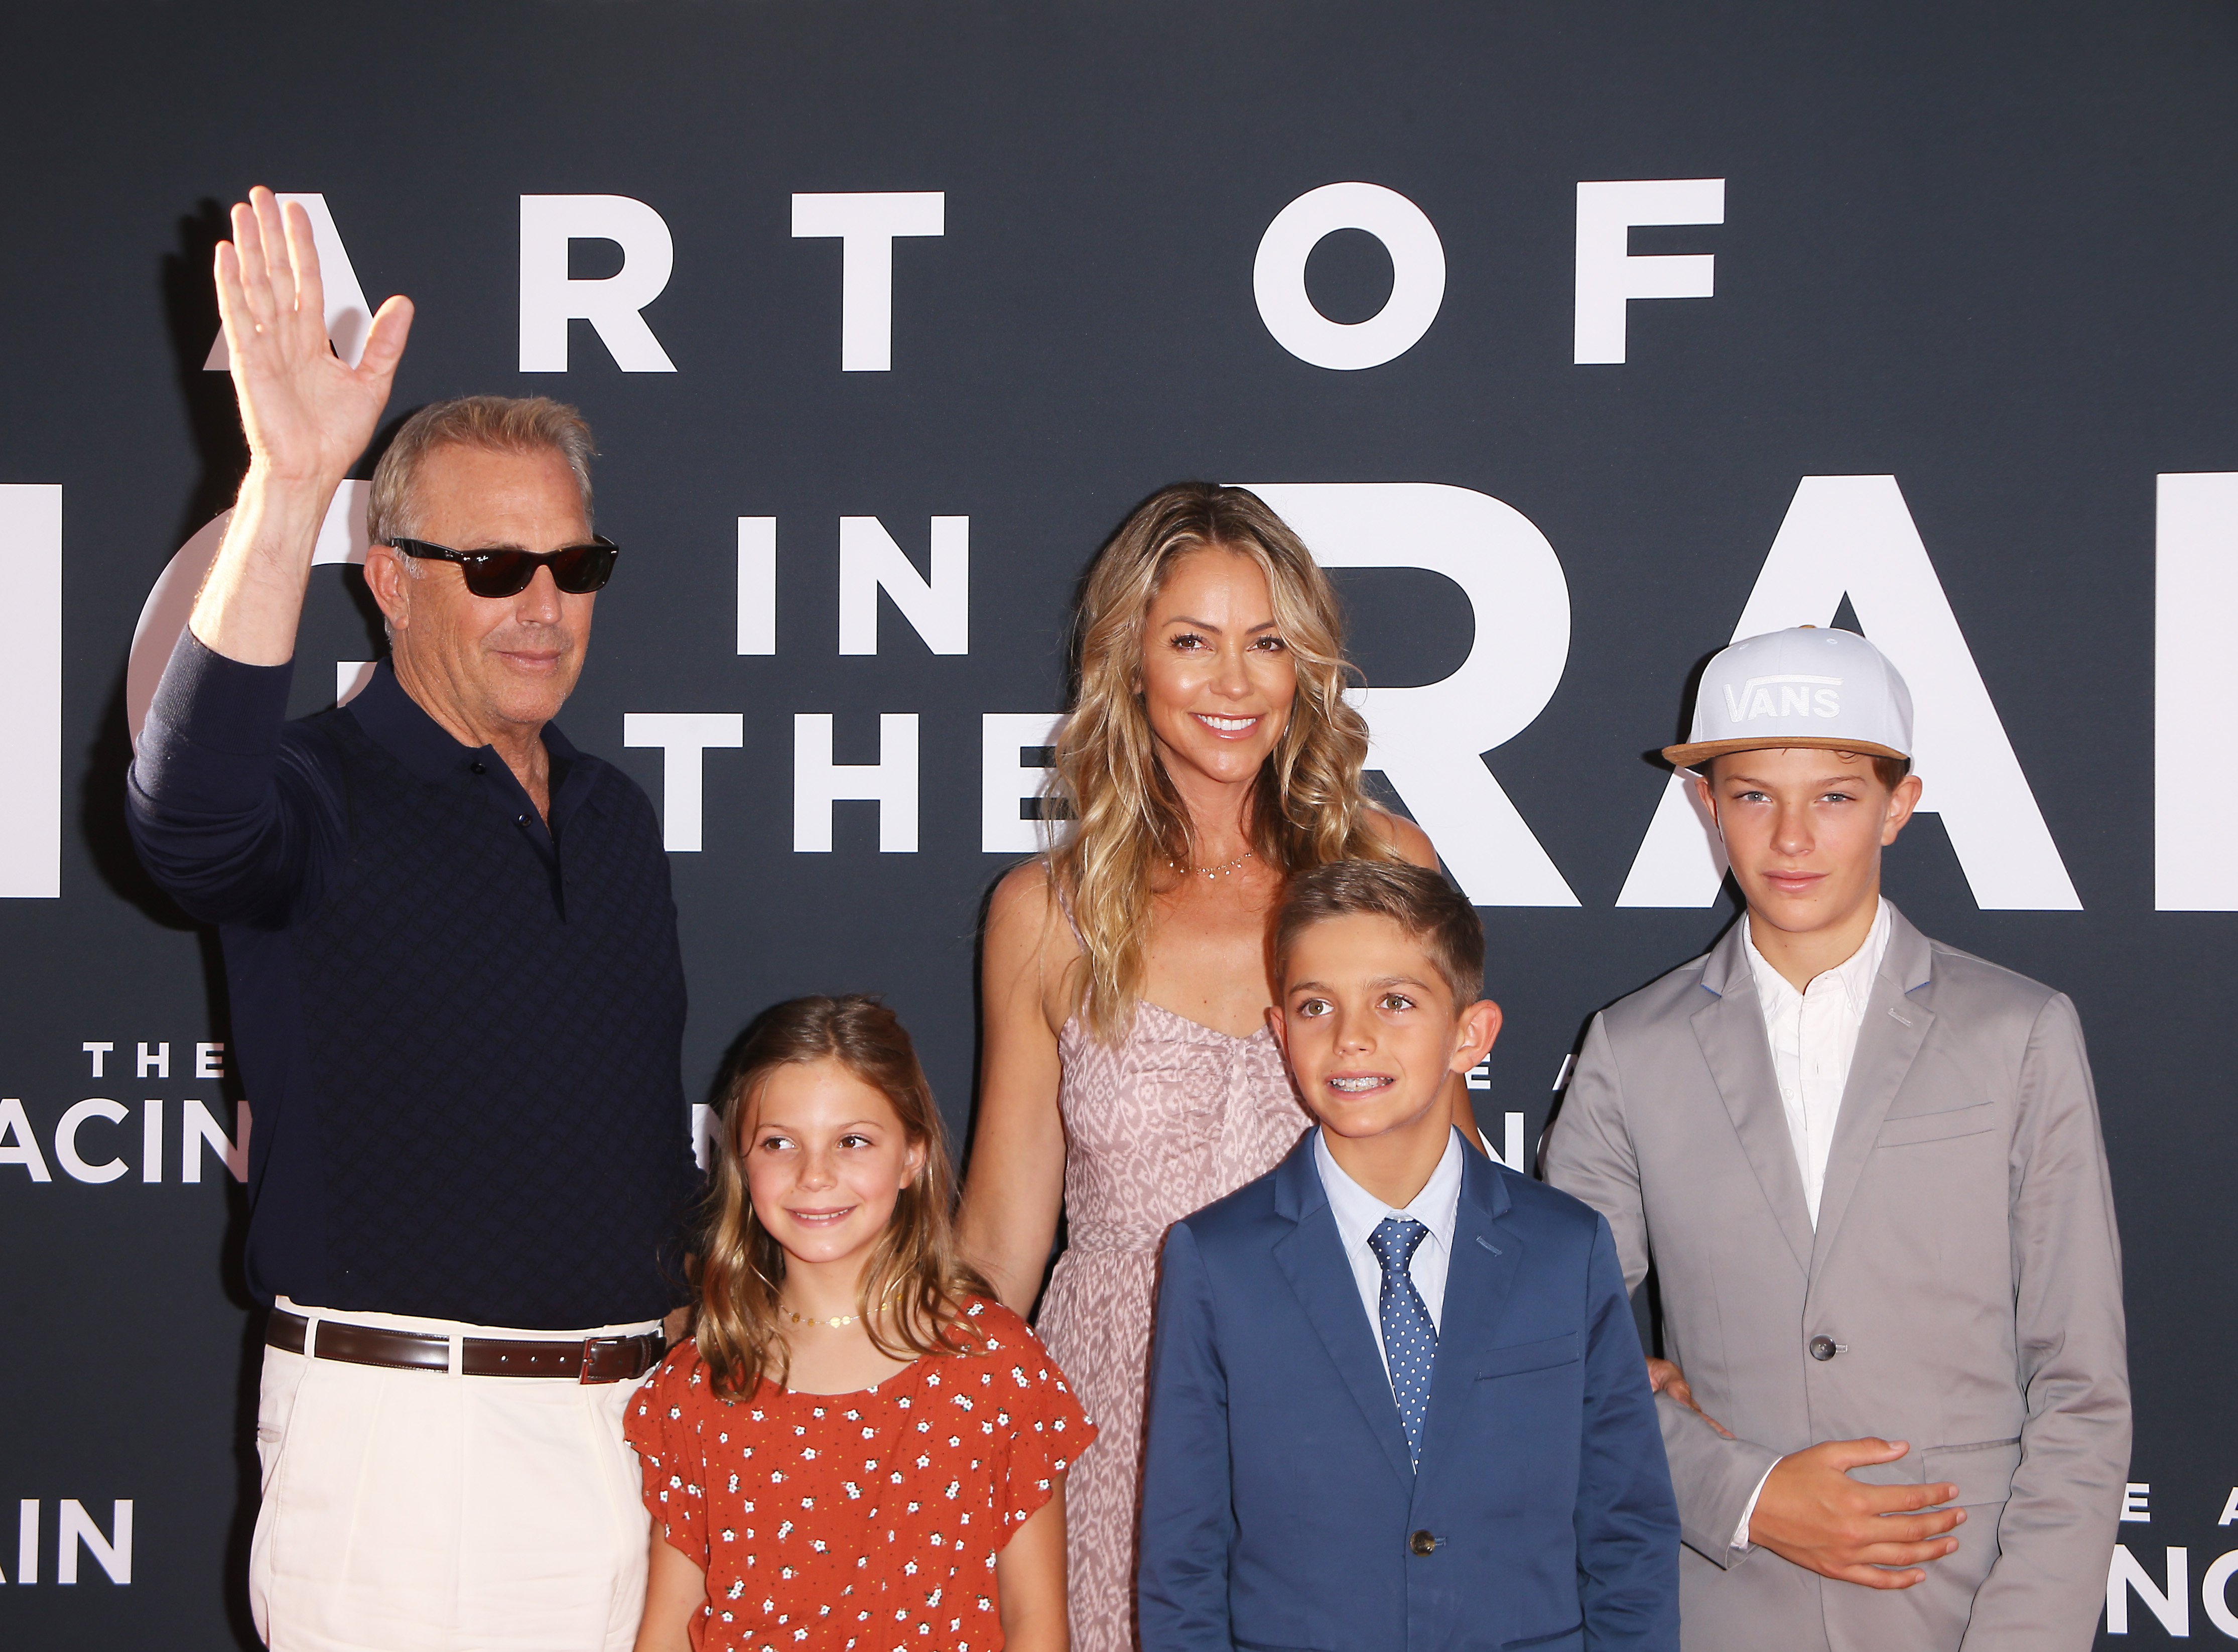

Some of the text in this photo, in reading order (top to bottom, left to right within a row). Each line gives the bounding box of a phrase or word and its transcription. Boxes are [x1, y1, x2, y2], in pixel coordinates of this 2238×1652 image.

[1253, 178, 1726, 370] OF
[737, 516, 969, 655] IN
[1722, 674, 1845, 723] VANS
[623, 713, 1080, 853] THE
[82, 1041, 225, 1078] THE
